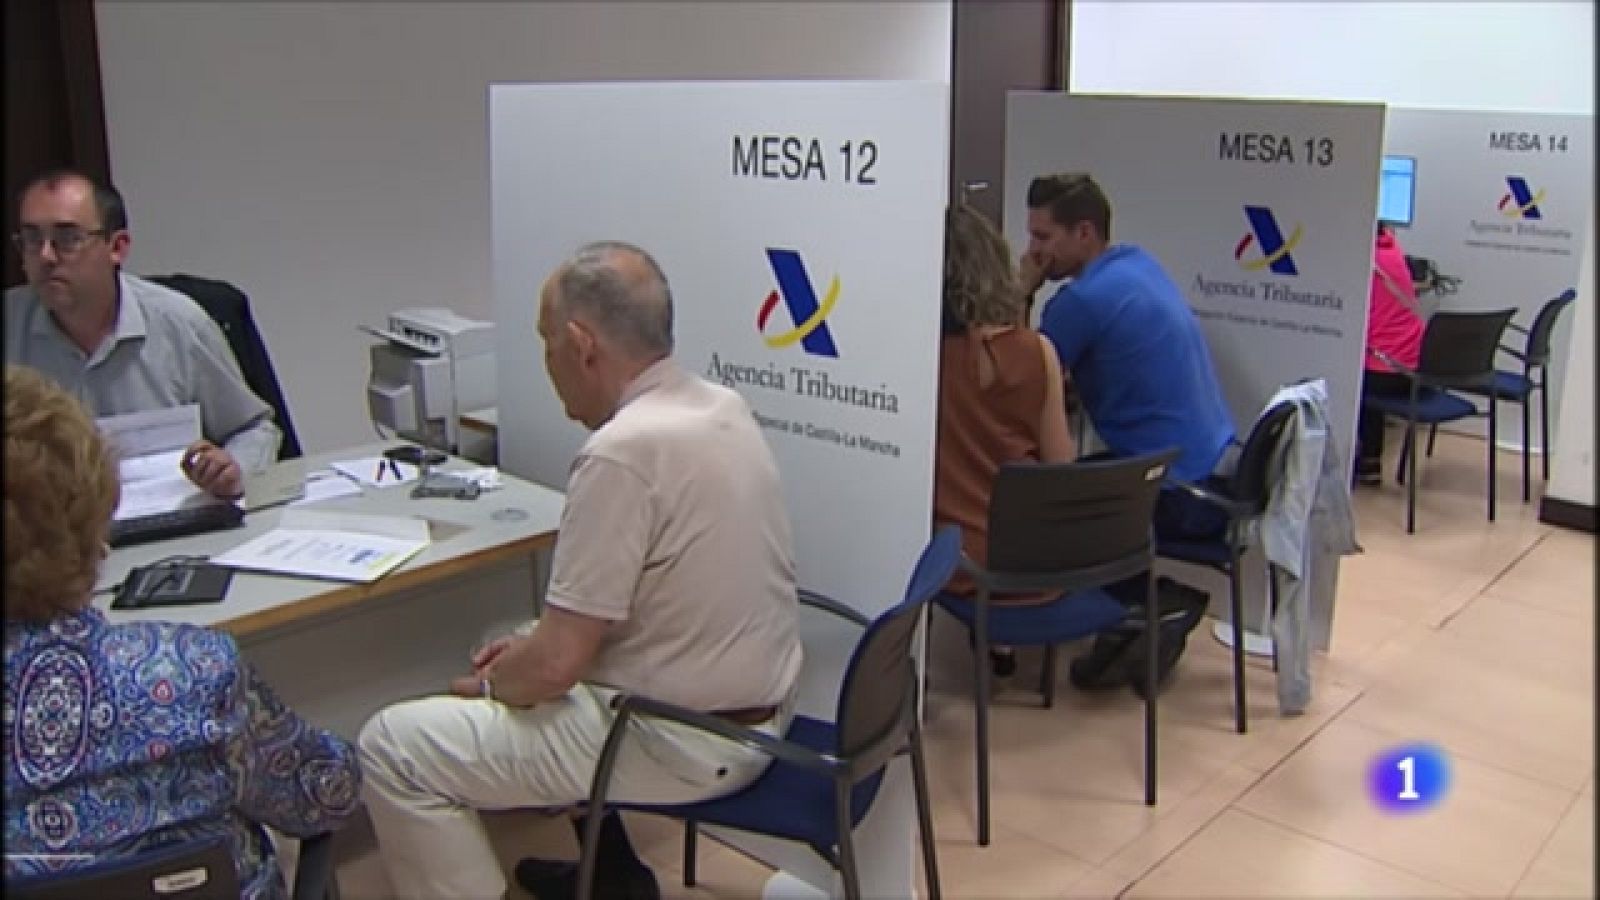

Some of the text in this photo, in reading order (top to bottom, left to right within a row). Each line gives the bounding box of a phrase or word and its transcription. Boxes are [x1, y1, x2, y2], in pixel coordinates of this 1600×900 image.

[732, 135, 878, 185] MESA 12
[1219, 132, 1335, 167] MESA 13
[1490, 130, 1569, 153] MESA 14
[707, 352, 899, 414] Agencia Tributaria
